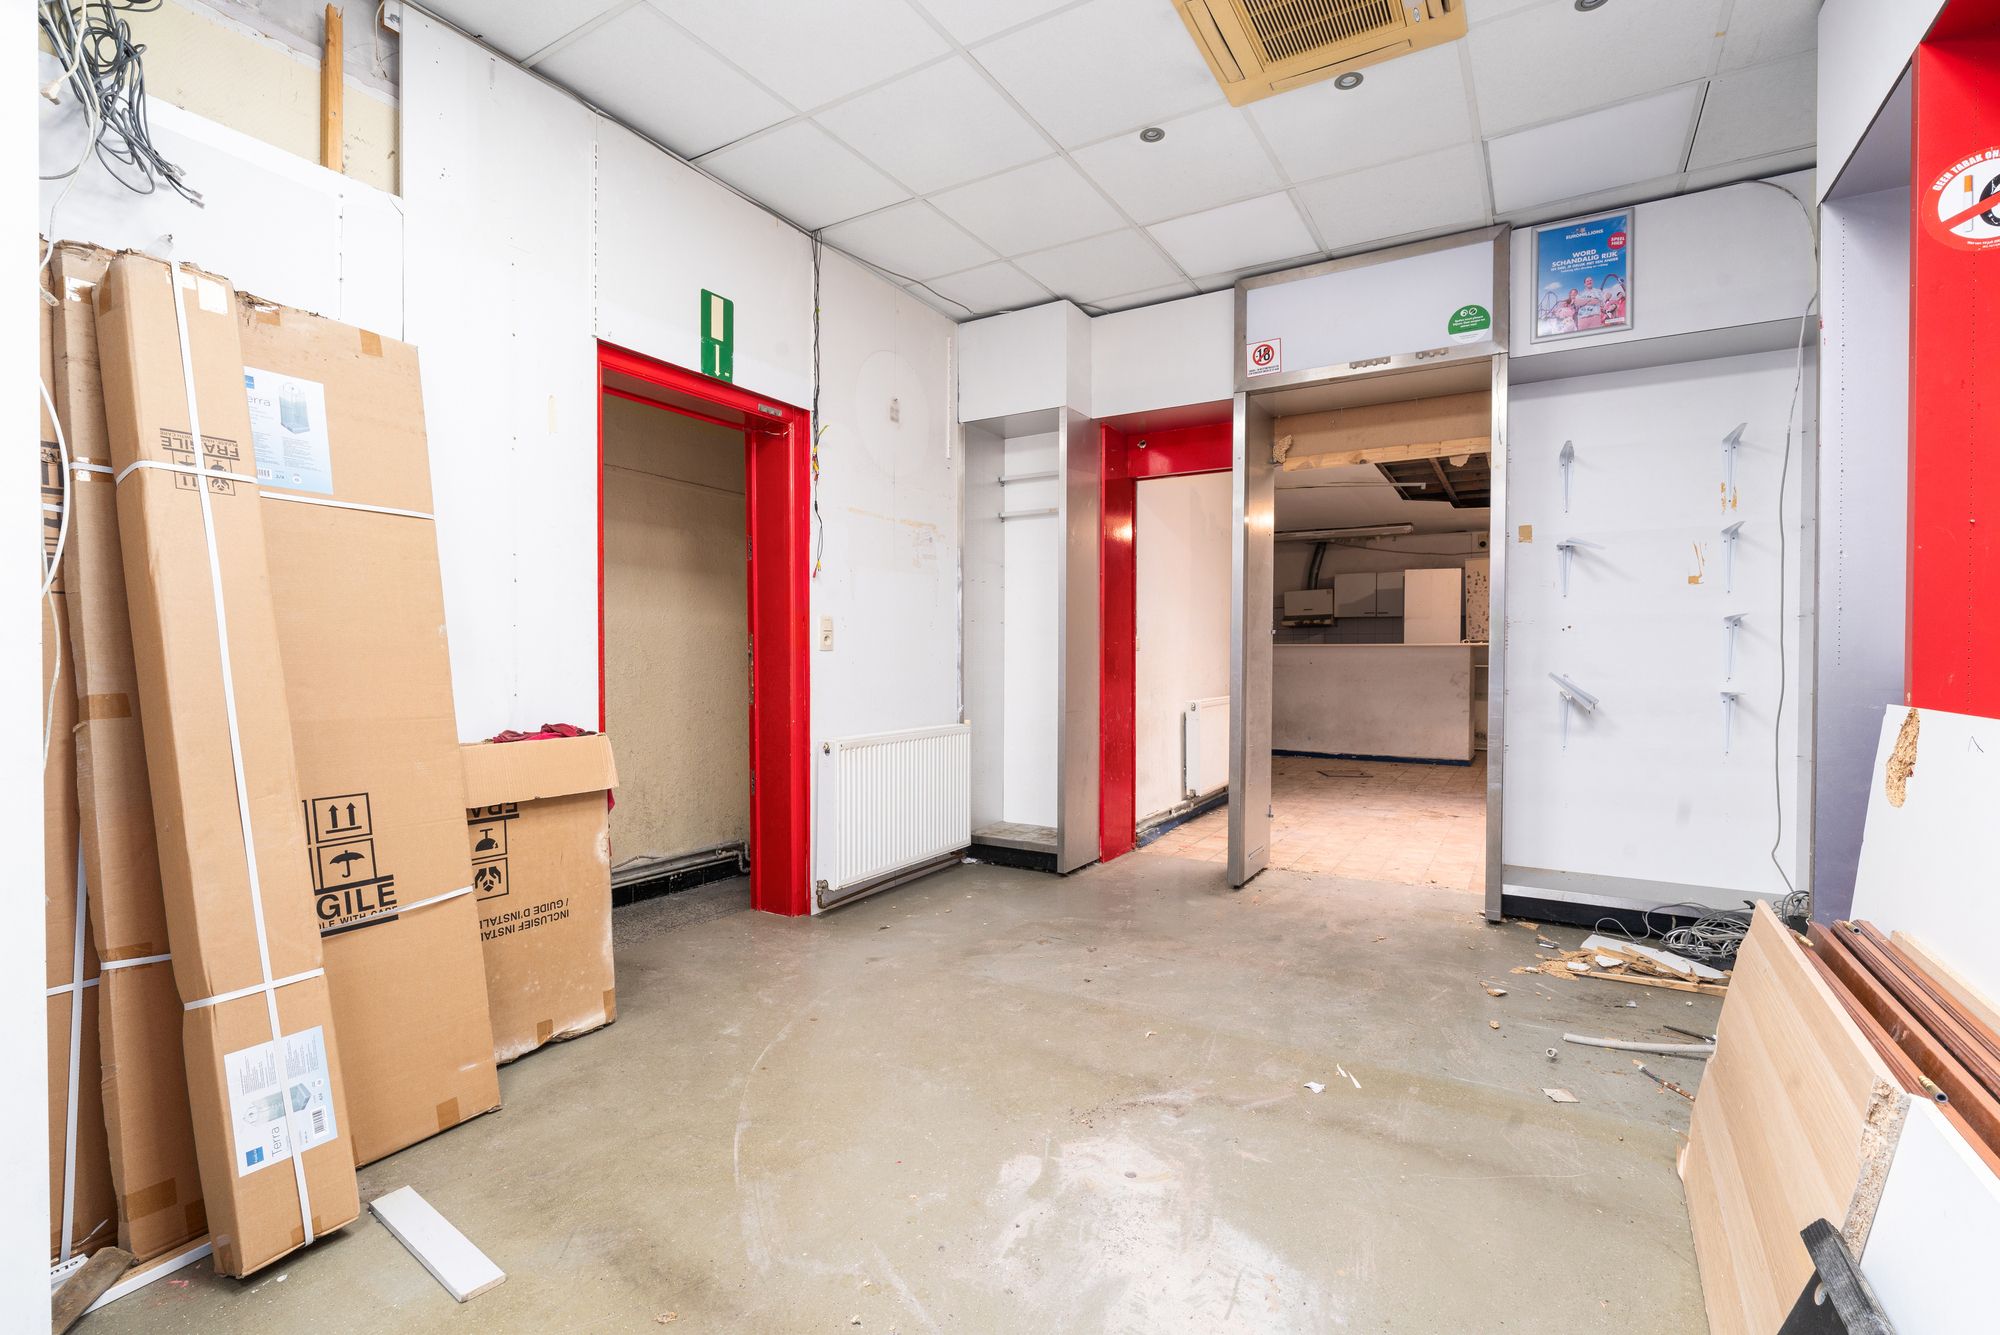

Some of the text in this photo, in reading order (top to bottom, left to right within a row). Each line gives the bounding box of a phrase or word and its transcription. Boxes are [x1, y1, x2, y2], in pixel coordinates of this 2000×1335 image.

[1932, 149, 2000, 191] GEEN TABAK ON
[1566, 229, 1604, 239] EUROMILLIONS
[1572, 249, 1596, 257] WORD
[1552, 255, 1599, 267] SCHANDALIG
[248, 395, 271, 407] erra
[316, 881, 397, 921] GILE
[533, 899, 564, 912] GUIDE
[518, 908, 569, 931] INCLUSIEF
[271, 1126, 283, 1157] Terra
